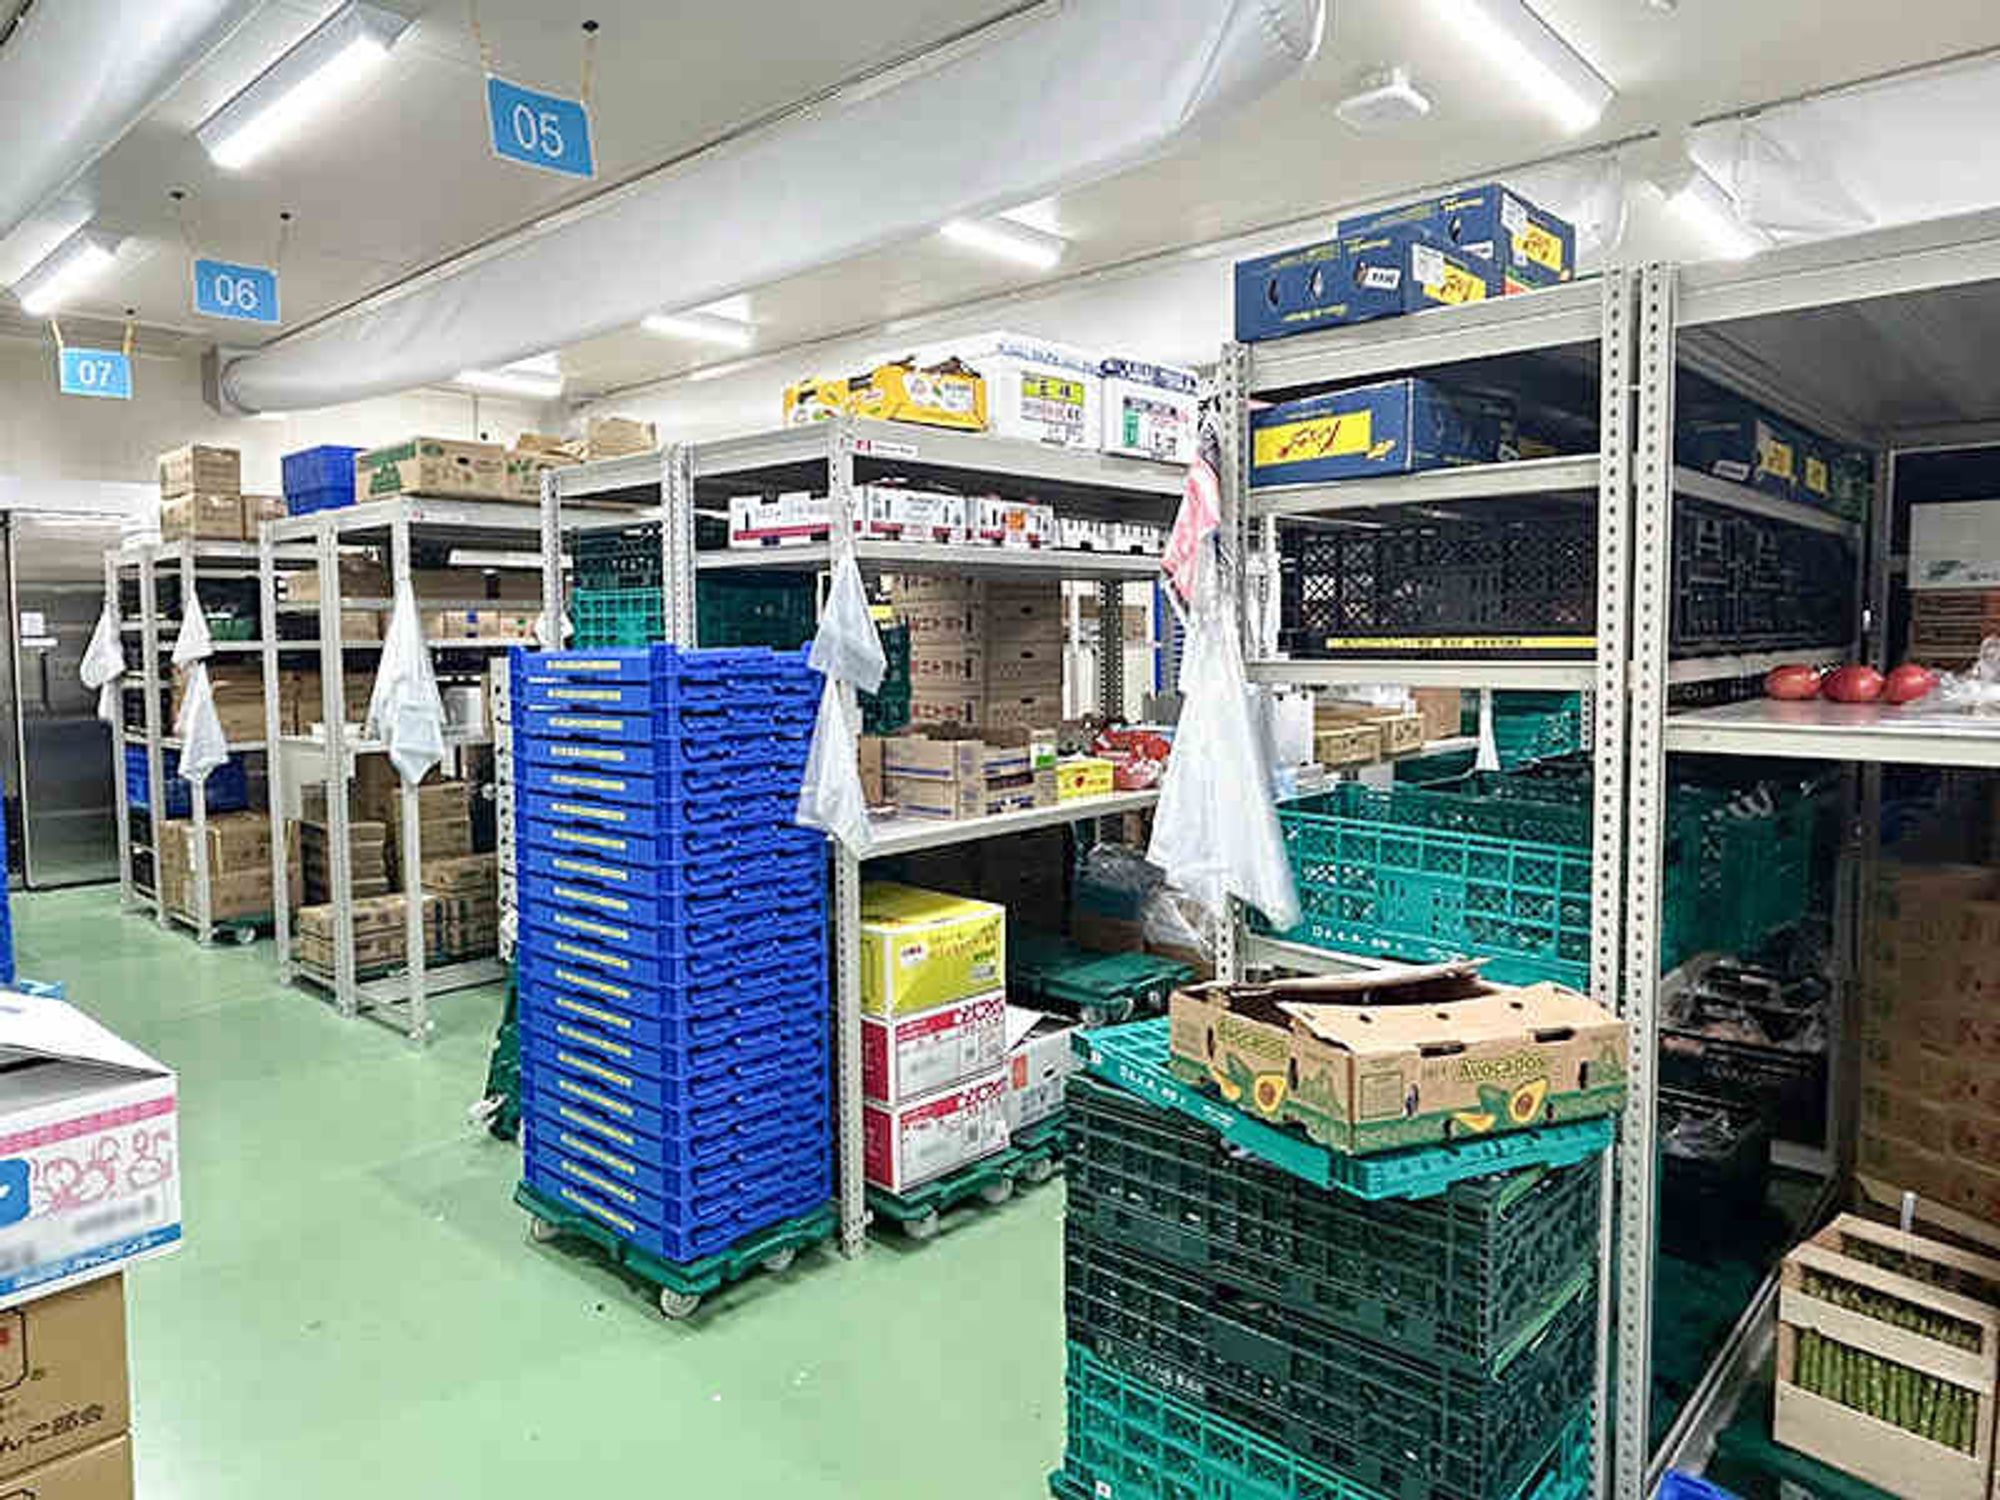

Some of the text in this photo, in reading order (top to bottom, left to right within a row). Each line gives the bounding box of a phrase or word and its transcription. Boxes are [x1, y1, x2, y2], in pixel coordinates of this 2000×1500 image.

[513, 103, 563, 157] 05
[215, 273, 257, 311] 06
[80, 360, 112, 387] 07
